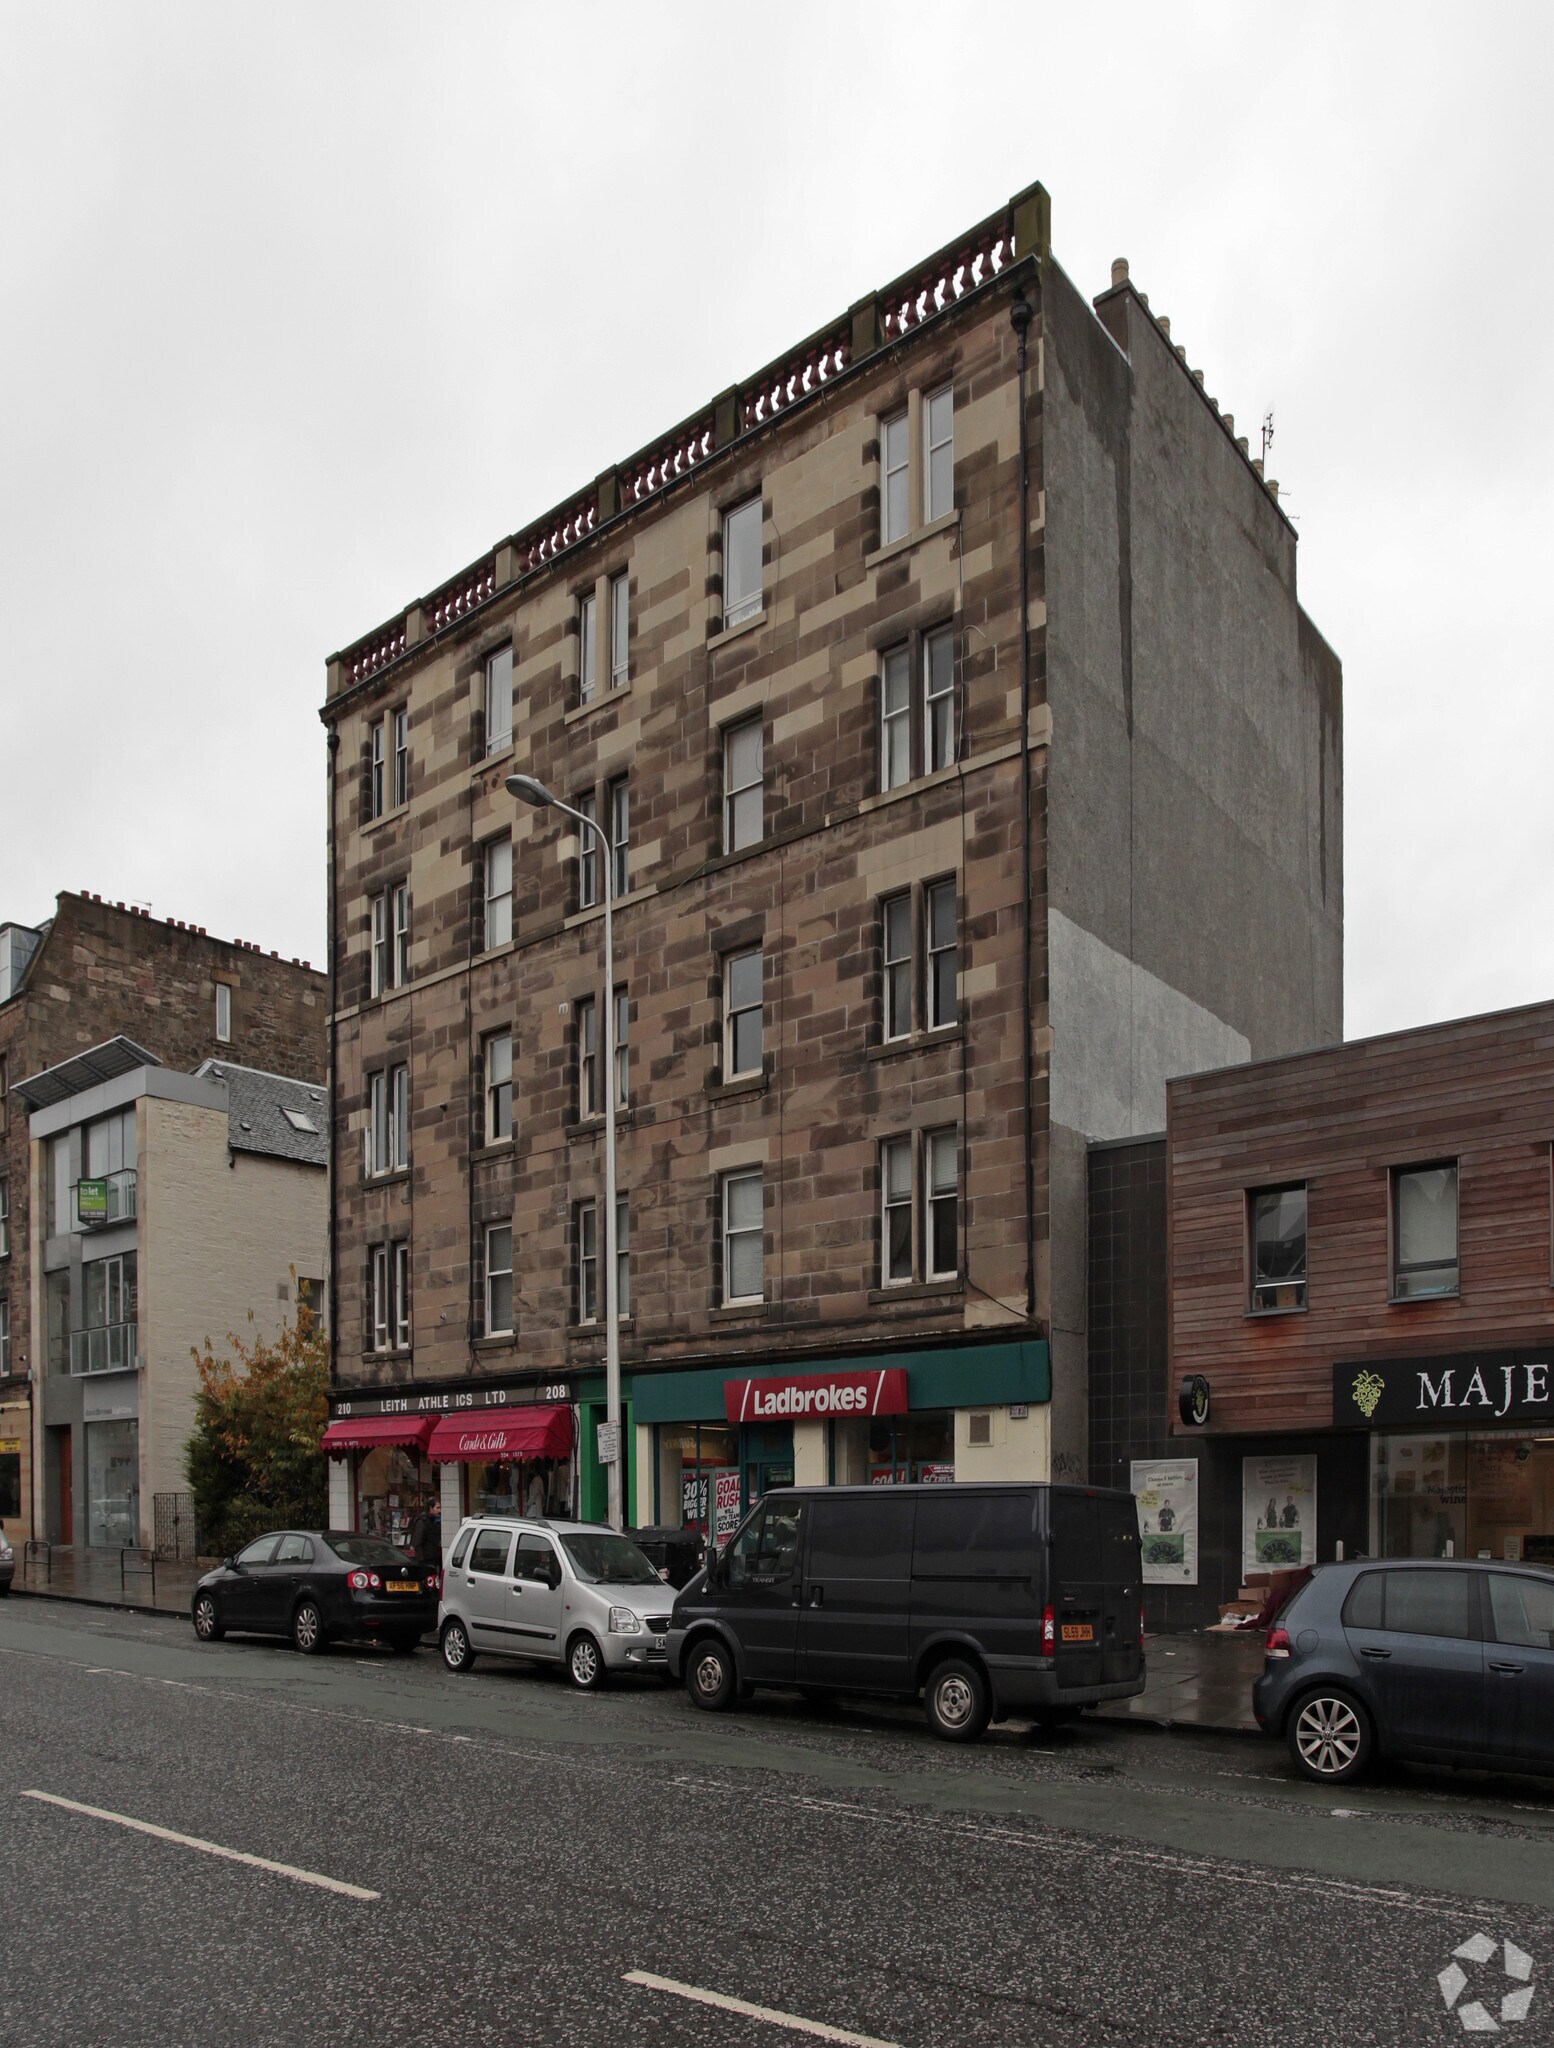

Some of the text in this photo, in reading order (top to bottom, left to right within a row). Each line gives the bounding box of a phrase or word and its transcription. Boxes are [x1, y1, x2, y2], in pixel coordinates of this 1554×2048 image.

[88, 1186, 98, 1196] let
[546, 1384, 566, 1400] 208
[1416, 1364, 1549, 1417] MAJE
[380, 1399, 407, 1413] LEITH
[485, 1390, 506, 1405] LTD
[754, 1384, 867, 1415] Ladbrokes
[337, 1402, 351, 1415] 210
[683, 1478, 708, 1500] 30%
[717, 1477, 740, 1495] GOAL
[716, 1492, 740, 1509] RUSH
[687, 1507, 706, 1519] WIS
